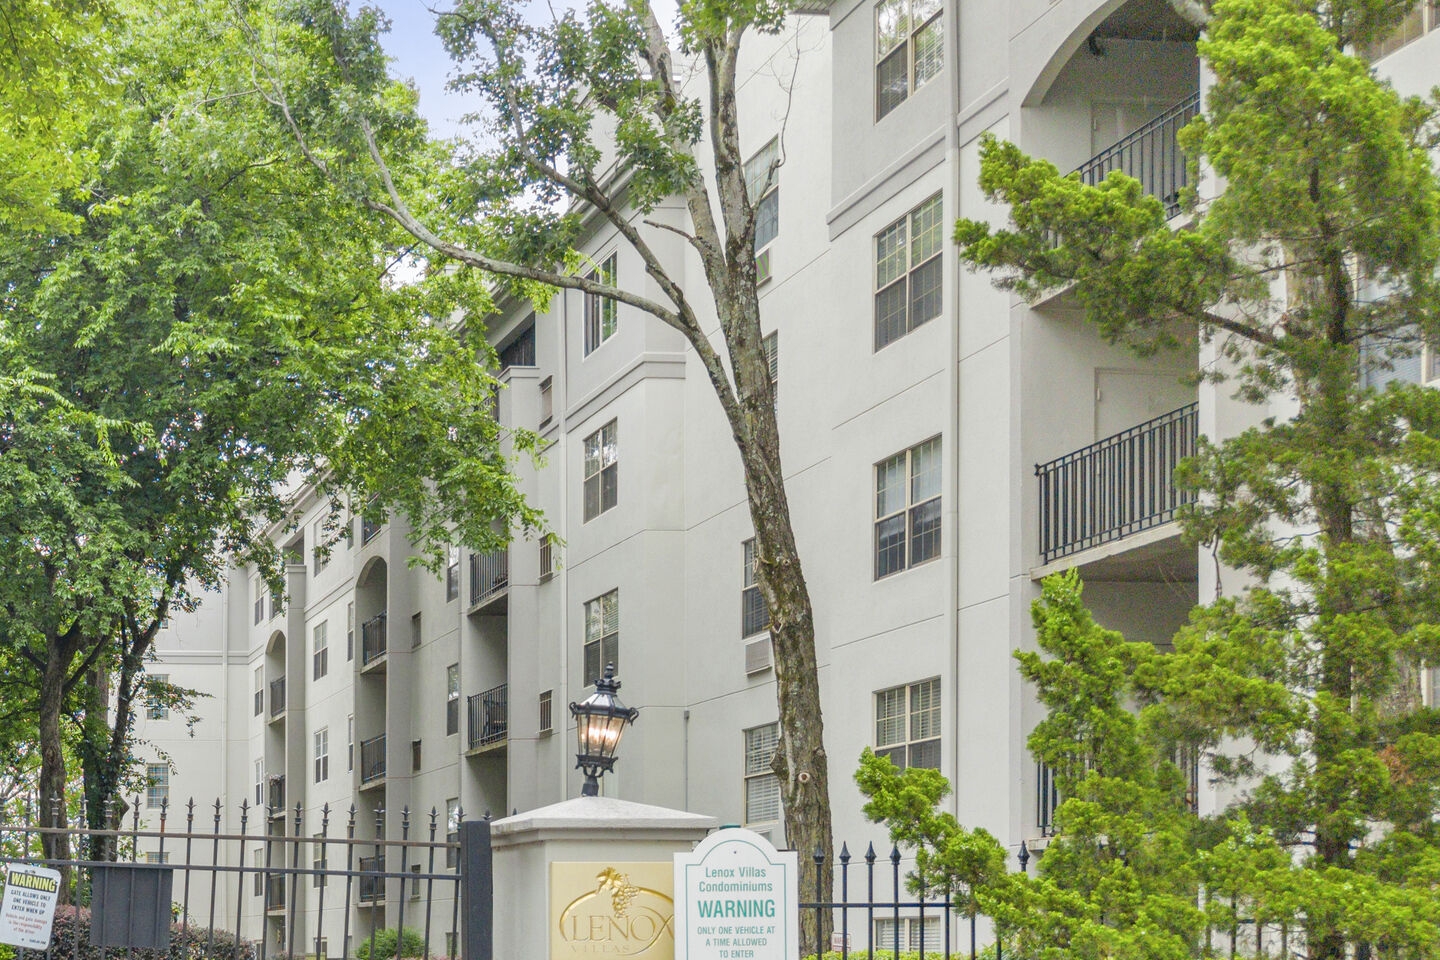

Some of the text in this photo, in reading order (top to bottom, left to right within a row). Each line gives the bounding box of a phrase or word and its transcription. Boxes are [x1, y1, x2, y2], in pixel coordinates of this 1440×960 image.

[706, 866, 766, 878] Lenox Villas
[11, 872, 56, 892] WARNING
[699, 881, 773, 892] Condominiums
[698, 899, 775, 918] WARNING
[697, 926, 716, 934] ONLY
[733, 938, 767, 946] ALLOWED
